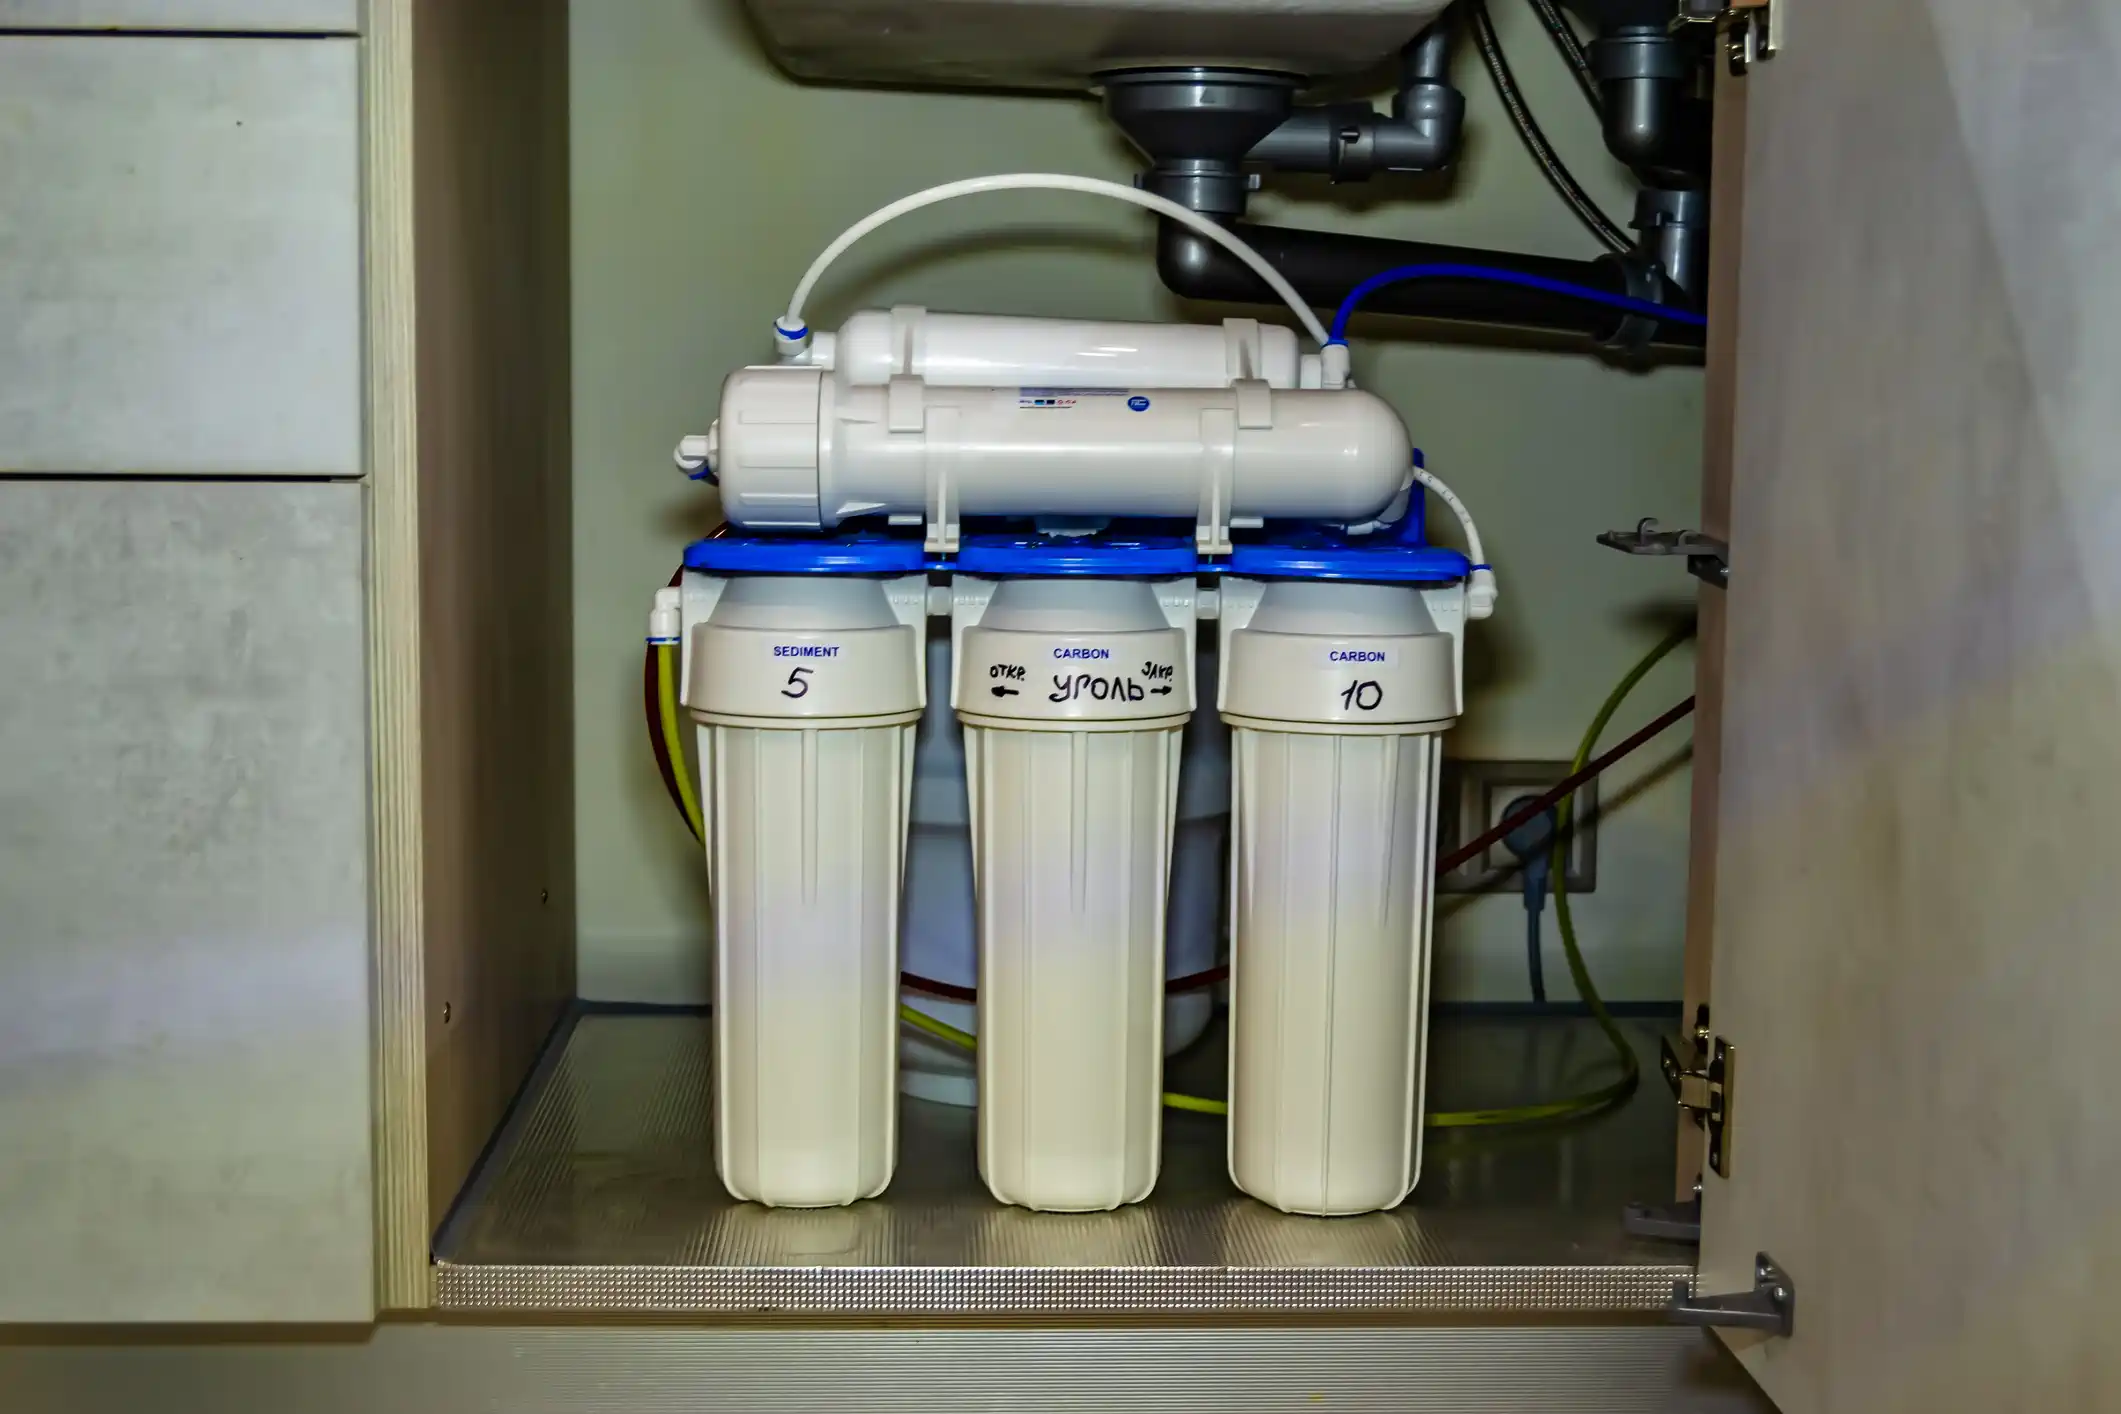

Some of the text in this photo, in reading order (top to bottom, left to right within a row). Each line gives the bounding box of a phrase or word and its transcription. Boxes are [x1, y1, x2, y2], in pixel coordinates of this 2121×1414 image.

[773, 645, 840, 657] SEDIMENT
[1053, 648, 1109, 659] CARBON
[1329, 651, 1385, 662] CARBON
[780, 667, 814, 699] 5
[1340, 679, 1384, 711] 10
